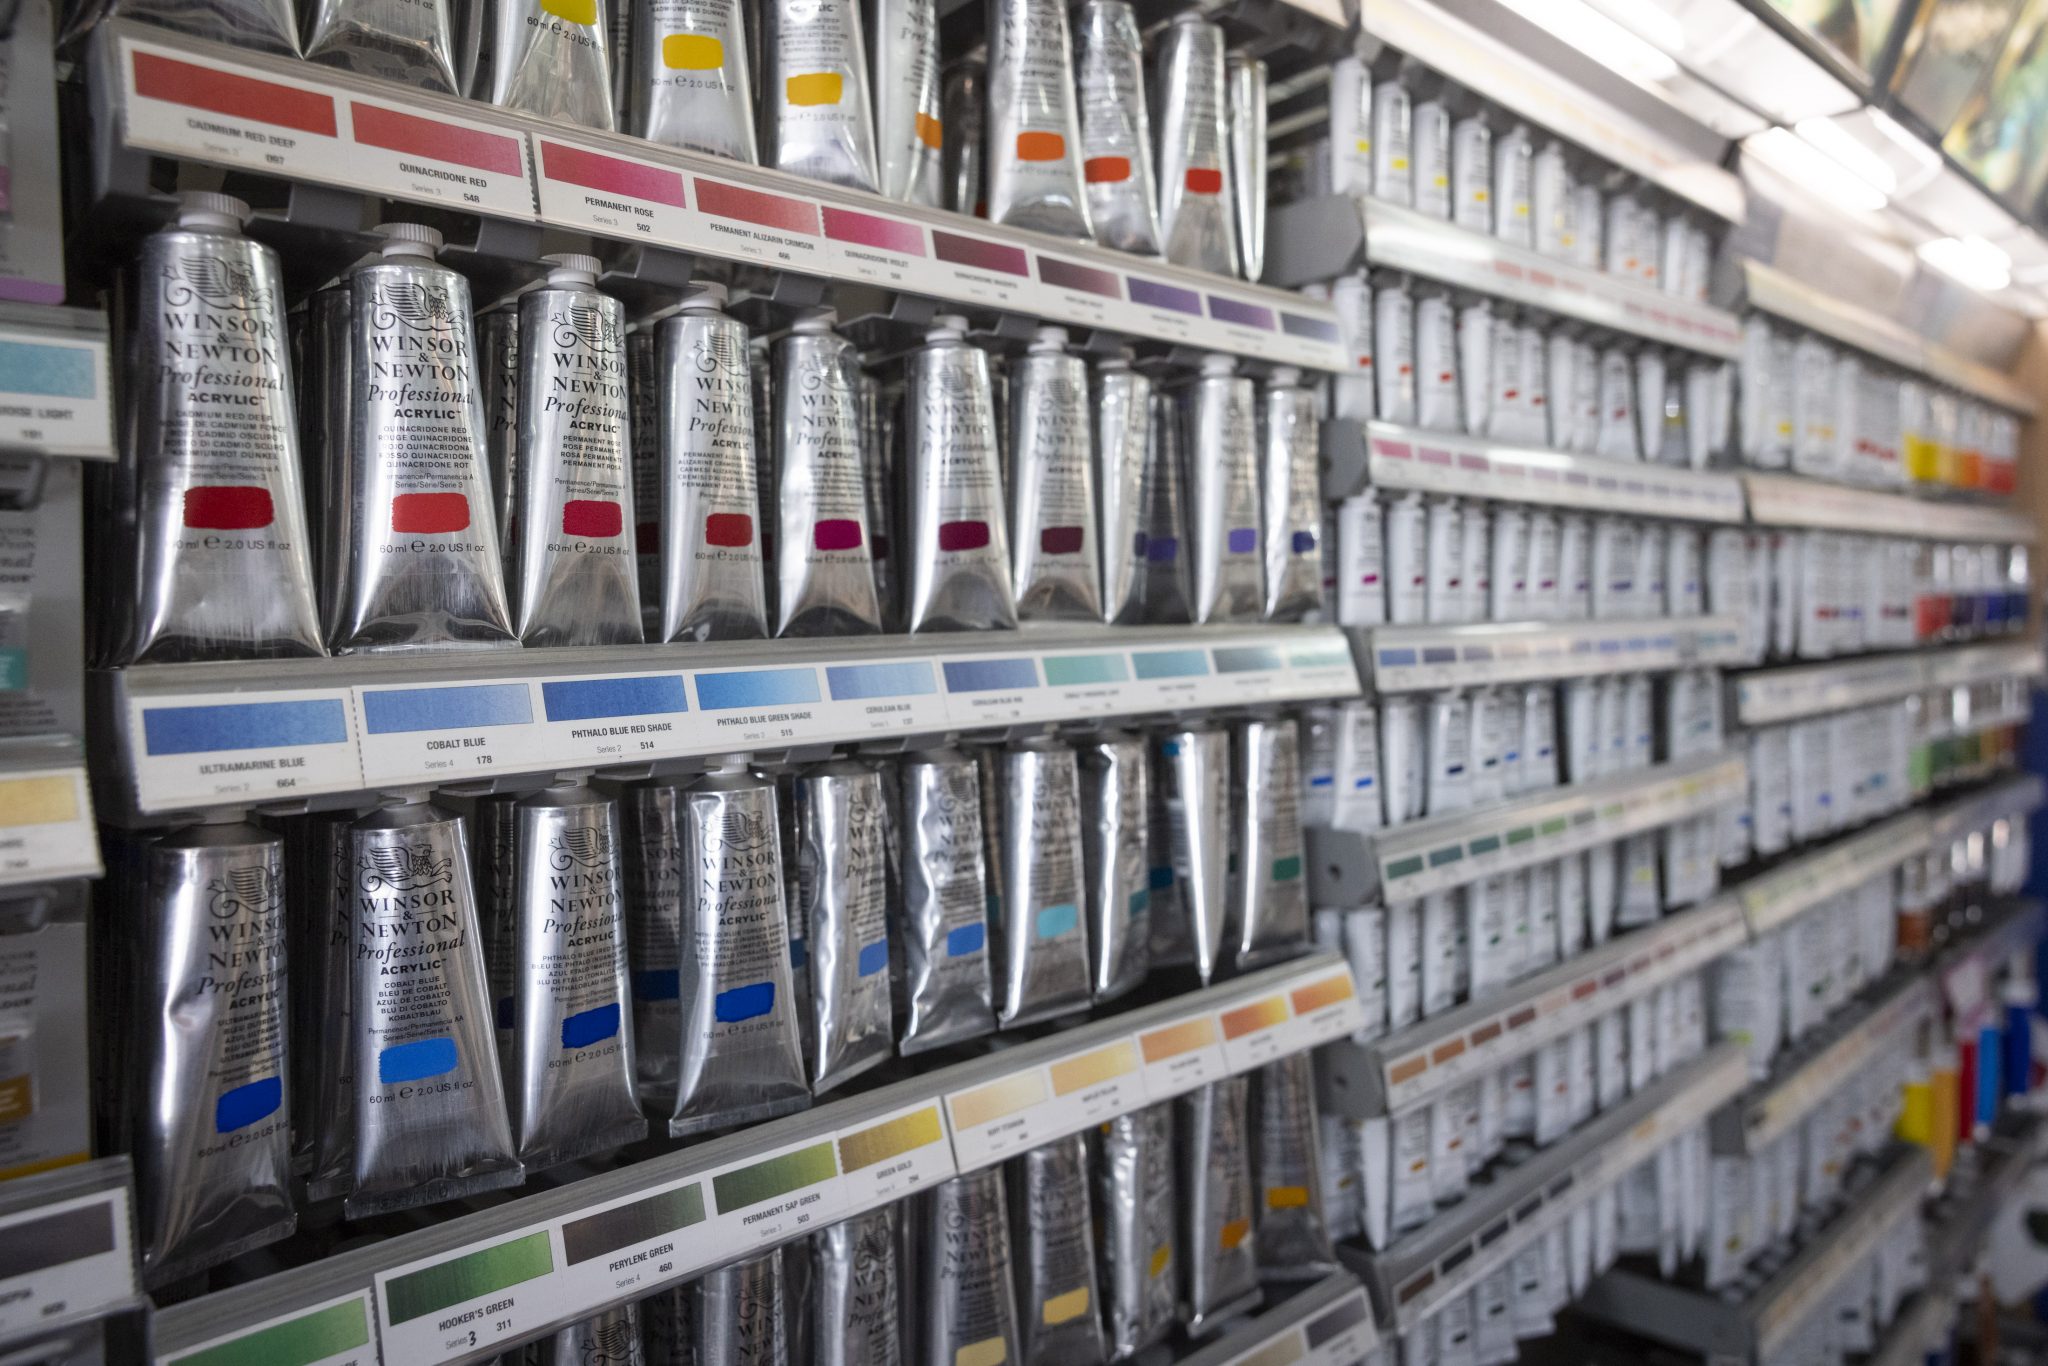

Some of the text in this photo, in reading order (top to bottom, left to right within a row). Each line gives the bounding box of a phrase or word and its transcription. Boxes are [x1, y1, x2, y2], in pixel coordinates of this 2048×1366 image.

[527, 16, 589, 46] 60 ml 2.0 US
[690, 80, 703, 88] 2.0
[186, 118, 296, 148] CADMIUM RED DEEP
[399, 162, 487, 188] QUINACRIDONE RED
[412, 183, 480, 203] Series 548
[585, 196, 654, 218] PERMANENT ROSE
[593, 214, 651, 233] Series 3 502
[710, 223, 814, 250] PERMANENT ALIZARIN CRIMSON
[164, 313, 277, 340] WINSOR
[217, 332, 230, 344] &
[372, 336, 468, 357] WINSOR
[165, 340, 277, 364] NEWTON
[418, 352, 429, 362] &
[374, 362, 469, 381] NEWTON
[553, 353, 626, 377] WINSOR
[159, 365, 285, 391] Professional
[593, 371, 602, 380] &
[368, 383, 474, 406] Professional
[553, 376, 626, 399] NEWTON
[225, 412, 246, 420] RED
[211, 421, 256, 430] CADMIUM
[213, 440, 252, 449] CADMIO
[410, 435, 472, 443] QUINACRIDONE
[563, 435, 606, 445] PERMANENT
[563, 460, 605, 469] PERMANENT
[186, 539, 200, 549] ml
[225, 540, 244, 549] 2.0
[248, 540, 265, 550] US
[268, 540, 276, 549] fl
[395, 544, 407, 552] ml
[448, 544, 464, 552] US
[548, 544, 560, 552] 60
[562, 544, 572, 552] ml
[866, 704, 911, 715] CERULEAN BLUE
[717, 712, 812, 727] PHTHALO BLUE GREEN SHADE
[572, 722, 672, 739] PHTHALO BLUE RED SHADE
[426, 737, 486, 750] COBALT BLUE
[597, 745, 616, 754] Series
[640, 741, 654, 750] 514
[200, 757, 306, 774] ULTRAMARINE BLUE
[424, 754, 492, 769] Series 4 178
[214, 778, 295, 794] Series 664
[703, 851, 775, 870] WINSOR
[550, 866, 621, 890] WINSOR
[739, 869, 746, 877] &
[589, 886, 597, 895] &
[704, 873, 776, 893] NEWTON
[360, 889, 456, 914] WINSOR
[551, 889, 622, 913] NEWTON
[403, 910, 414, 921] &
[361, 912, 456, 938] NEWTON
[257, 936, 265, 946] &
[357, 929, 465, 964] Professional
[578, 950, 594, 958] BLUE
[378, 990, 399, 998] BLEU
[417, 983, 447, 993] COBALT
[385, 976, 440, 989] COBALT BLUE
[377, 990, 450, 1006] AZUL DE COBALTO
[381, 1006, 396, 1014] BLU
[410, 999, 448, 1011] COBALTO
[388, 1009, 441, 1022] KOBALTBLAU
[756, 1023, 768, 1031] US
[549, 1045, 614, 1068] 60 ml 2.0 US
[369, 1096, 383, 1104] 60
[384, 1093, 395, 1102] ml
[418, 1086, 433, 1096] 2.0
[436, 1084, 450, 1093] US
[463, 1080, 473, 1089] oz
[262, 1126, 273, 1139] US
[876, 1161, 912, 1180] GREEN GOLD
[742, 1193, 820, 1226] PERMANENT SAP GREEN
[760, 1214, 809, 1238] Series 503
[609, 1243, 674, 1272] PERYLENE GREEN
[616, 1262, 673, 1288] Series 4 460
[439, 1297, 514, 1331] HOOKER'S GREEN
[446, 1319, 512, 1350] Series 3 311
